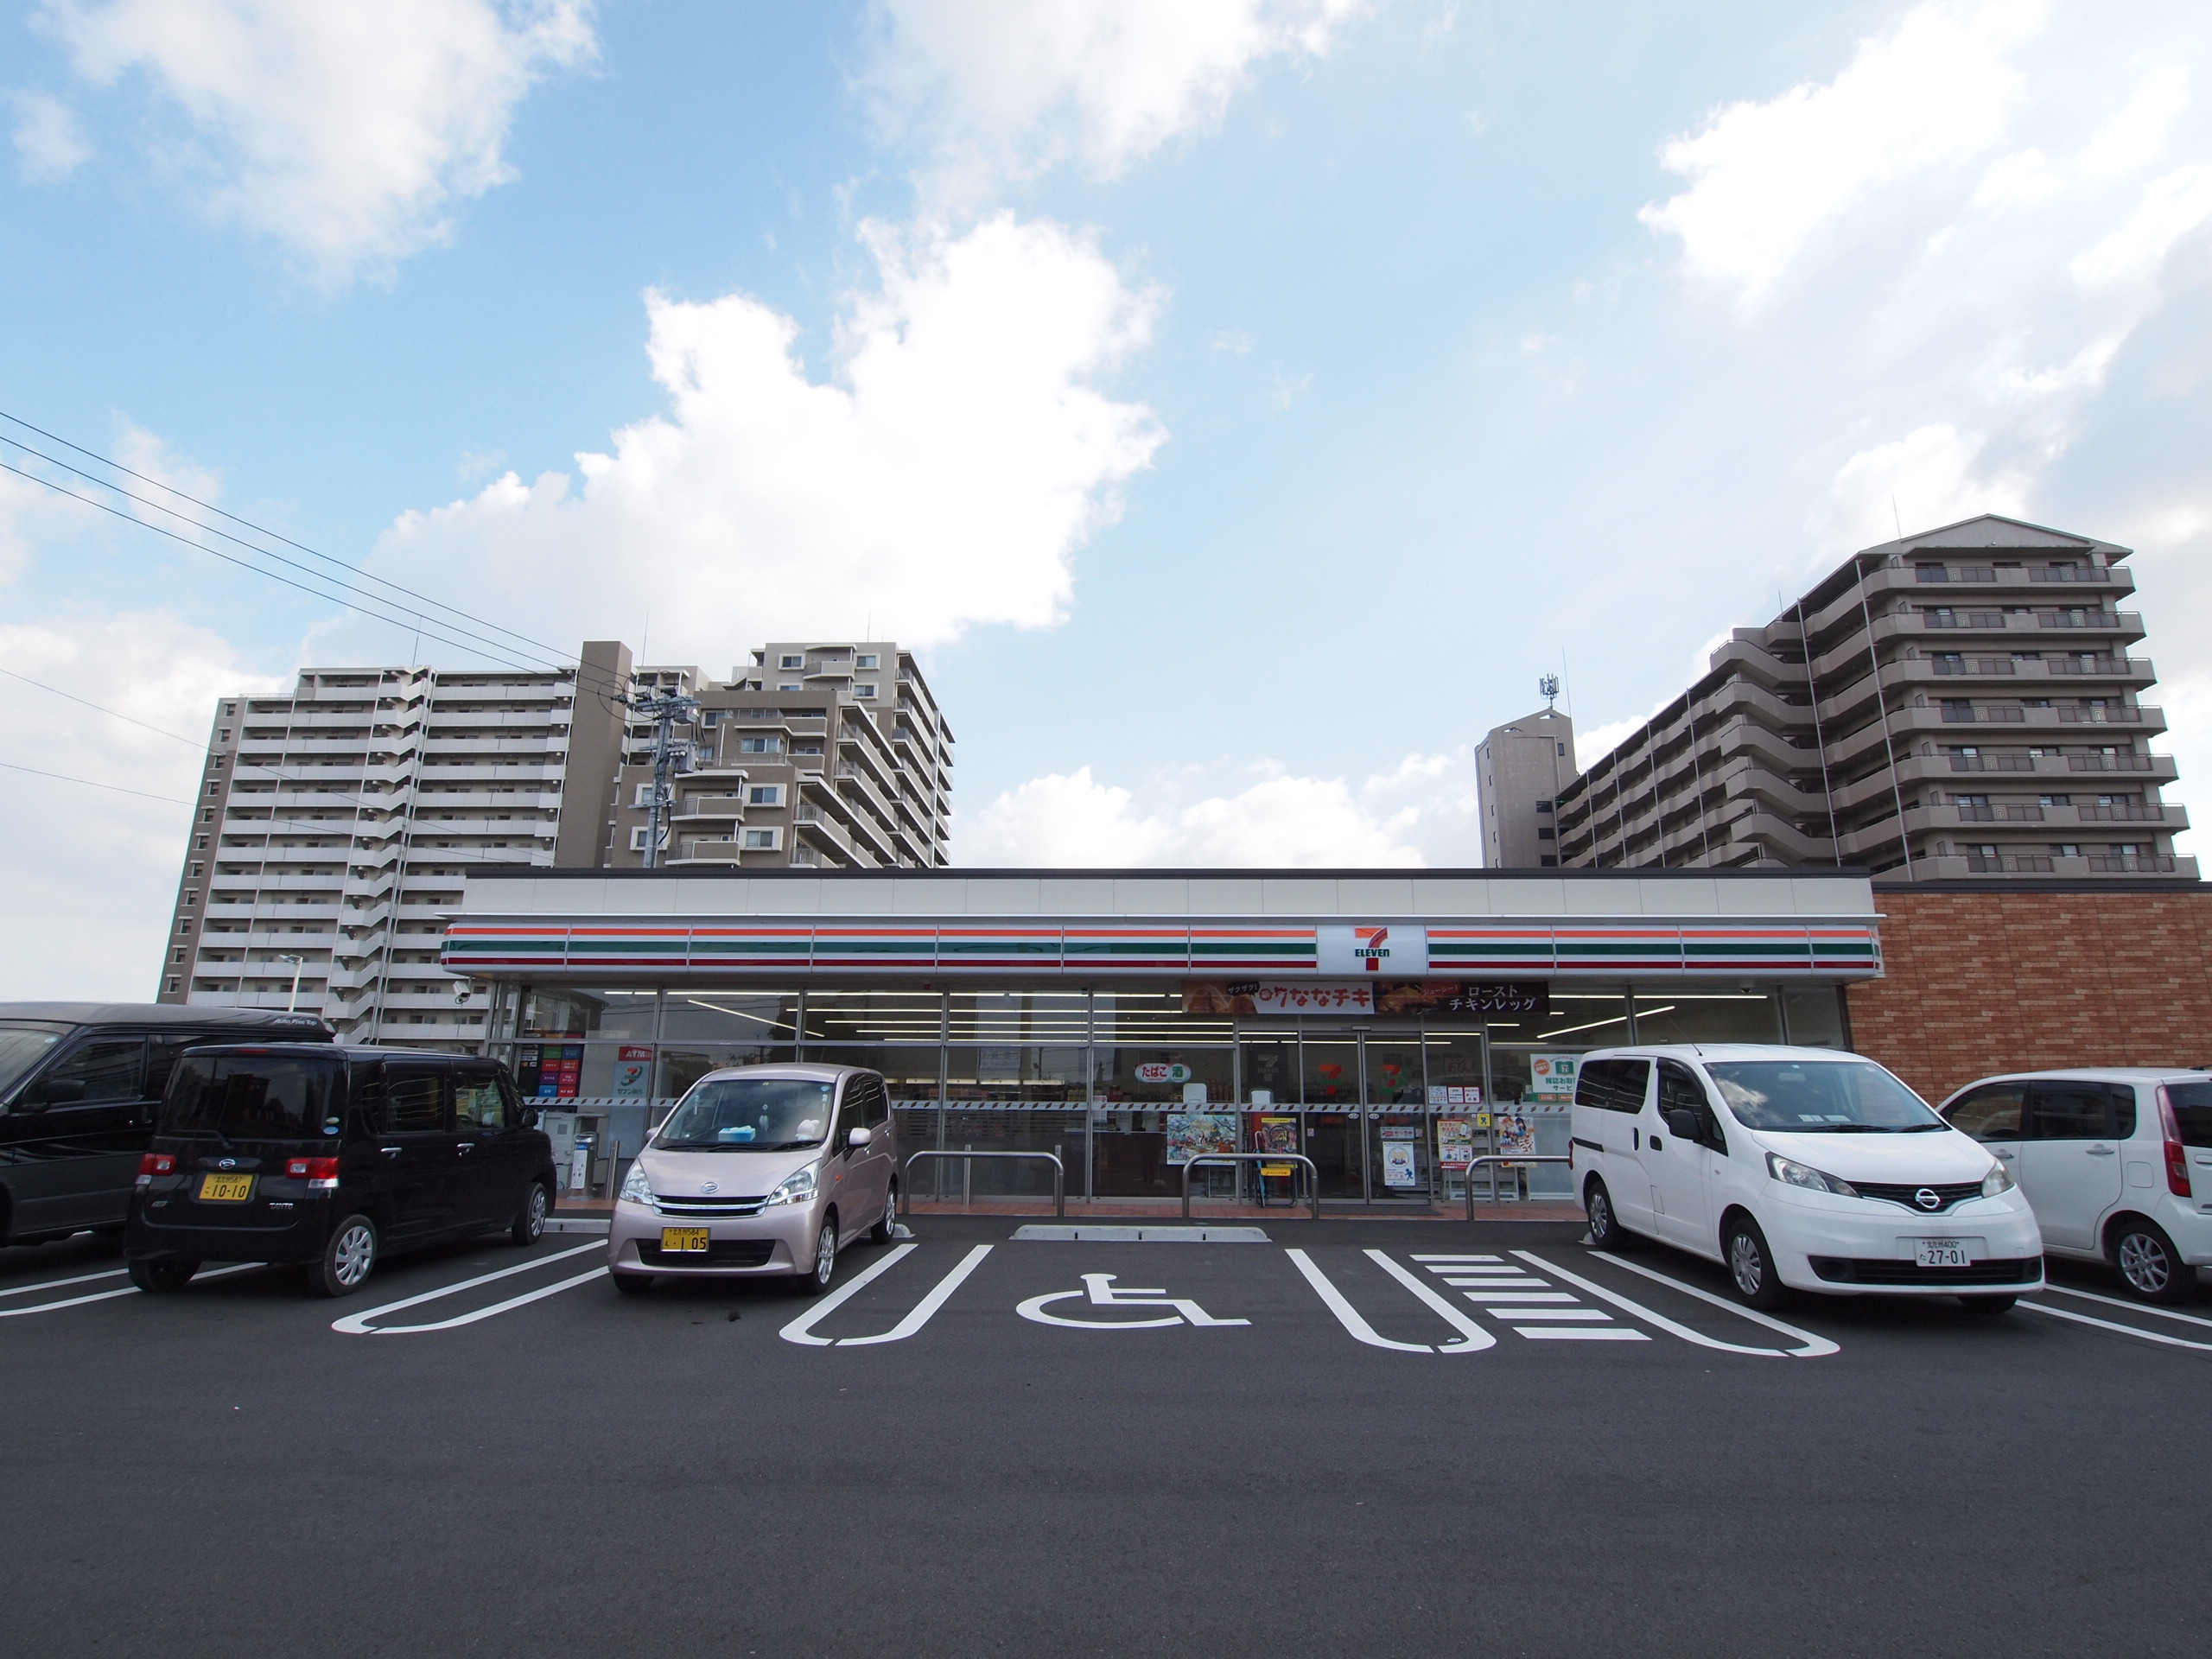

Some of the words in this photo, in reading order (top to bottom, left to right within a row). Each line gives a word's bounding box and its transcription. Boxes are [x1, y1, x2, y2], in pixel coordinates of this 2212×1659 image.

[1469, 985, 1517, 997] ロースト
[1449, 996, 1536, 1011] チキンレッグ
[1141, 1065, 1167, 1077] たばこ
[1173, 1066, 1183, 1077] 酒
[212, 1185, 246, 1198] 10-10
[1928, 1249, 1965, 1264] 27-01
